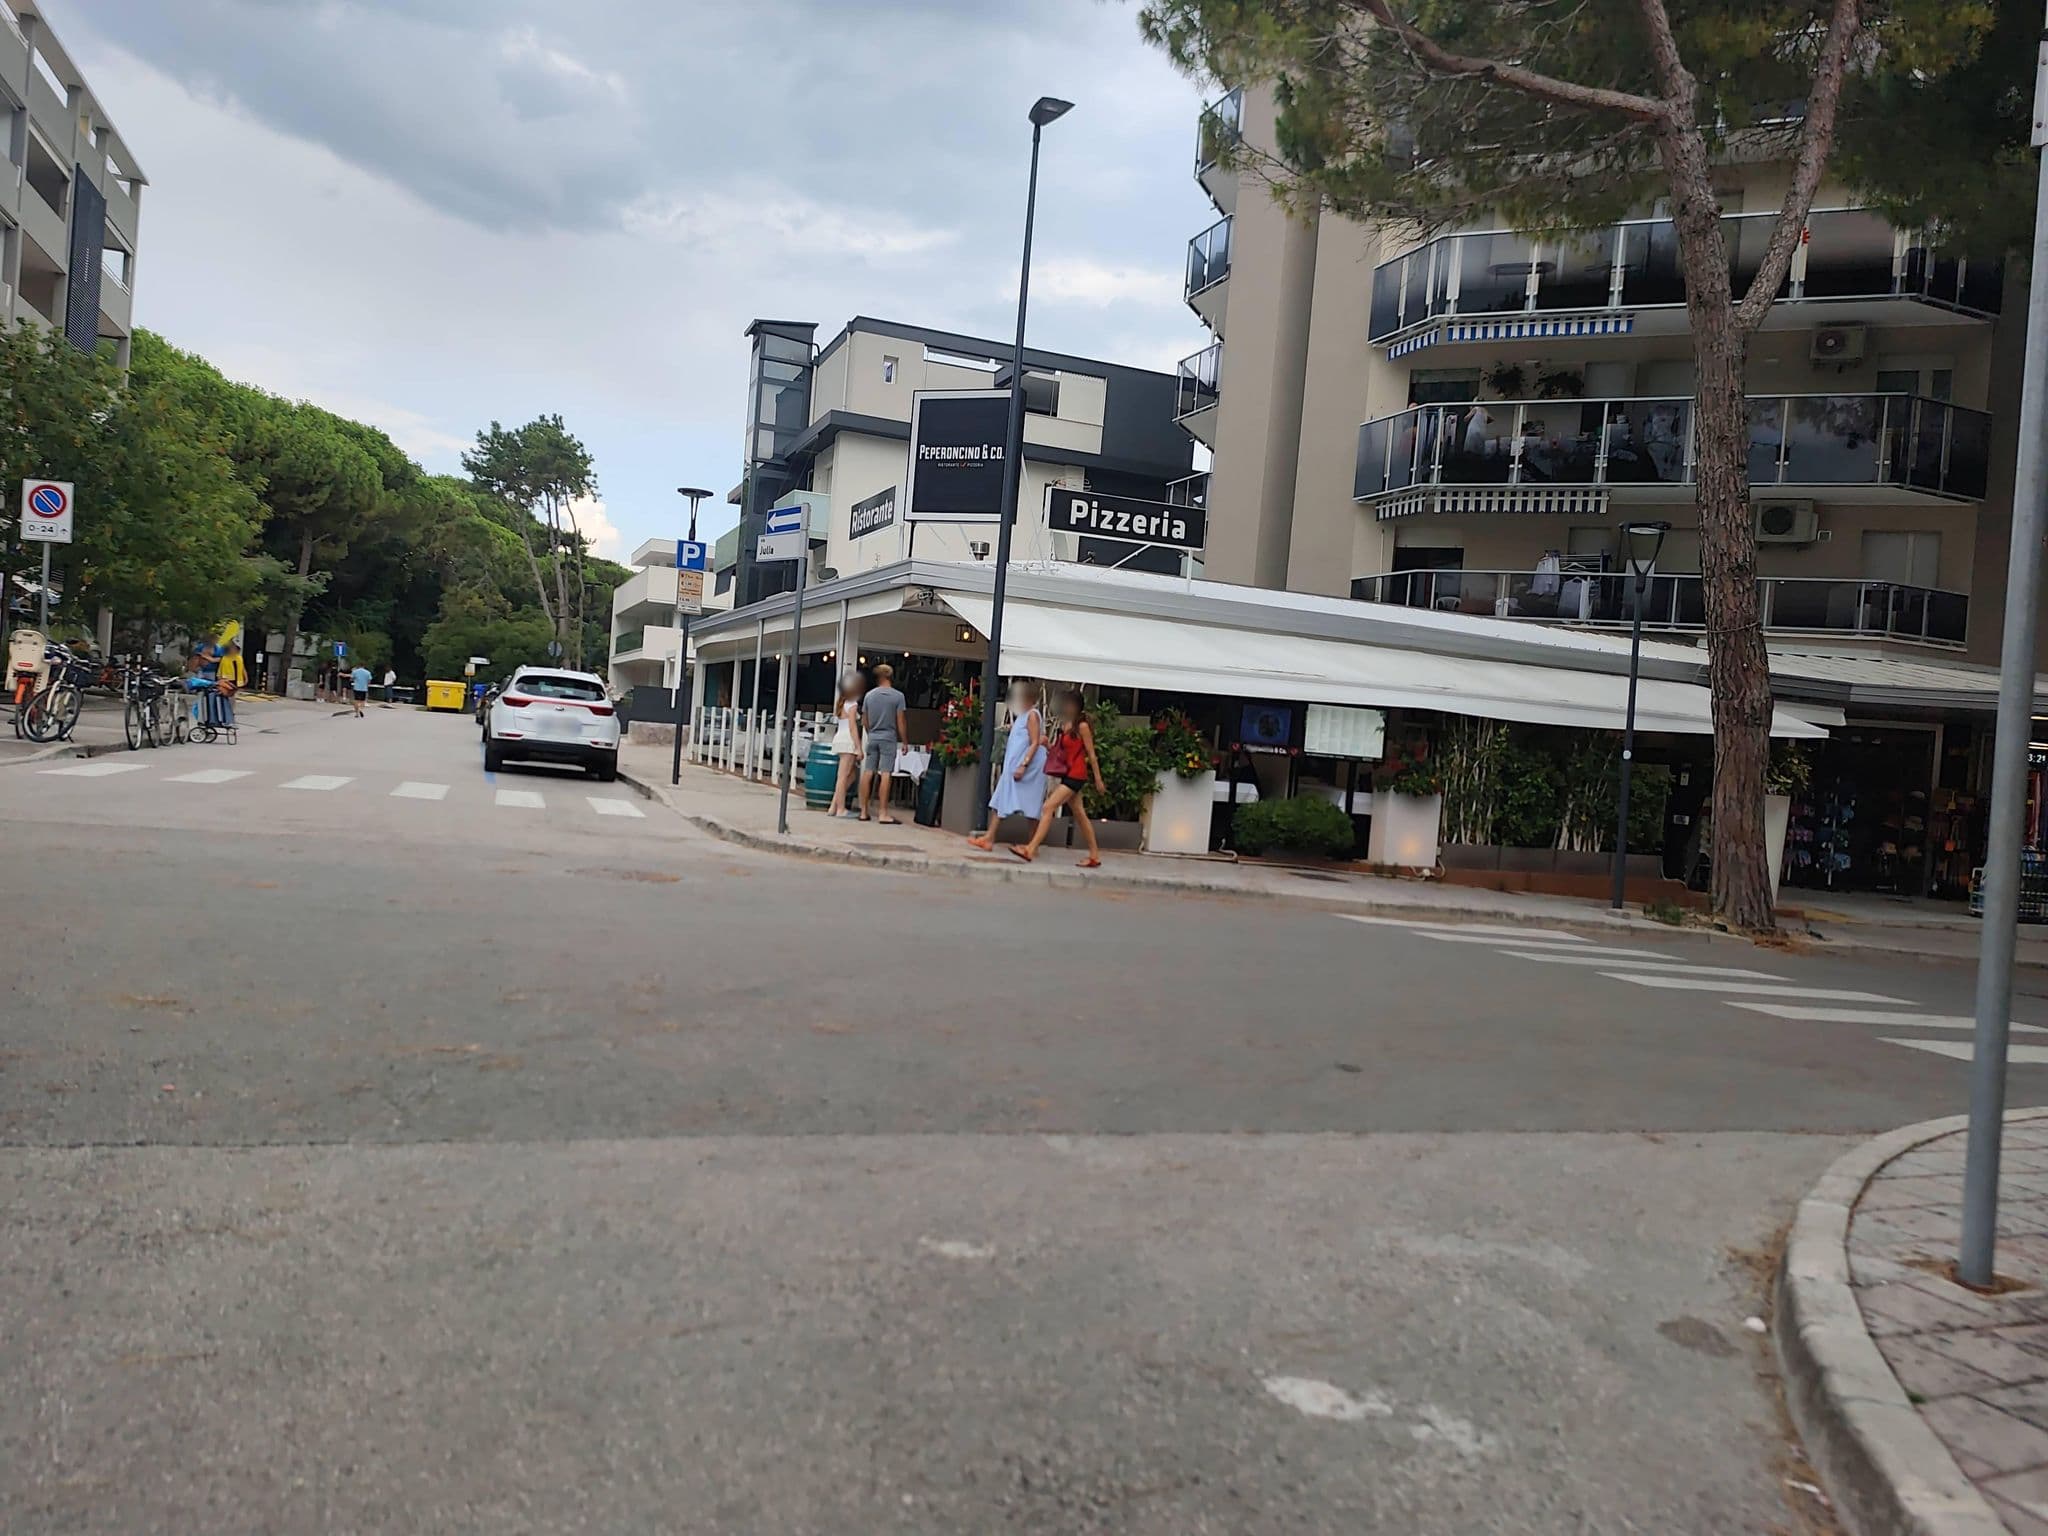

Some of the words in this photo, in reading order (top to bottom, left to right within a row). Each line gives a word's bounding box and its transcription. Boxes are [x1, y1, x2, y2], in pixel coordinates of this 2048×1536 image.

[919, 444, 981, 460] PEPERONCINO
[982, 443, 989, 460] &
[990, 446, 1005, 460] CO.
[851, 499, 894, 534] Ristorante
[1069, 498, 1187, 540] Pizzeria
[28, 524, 54, 533] 0-24
[681, 543, 701, 566] P
